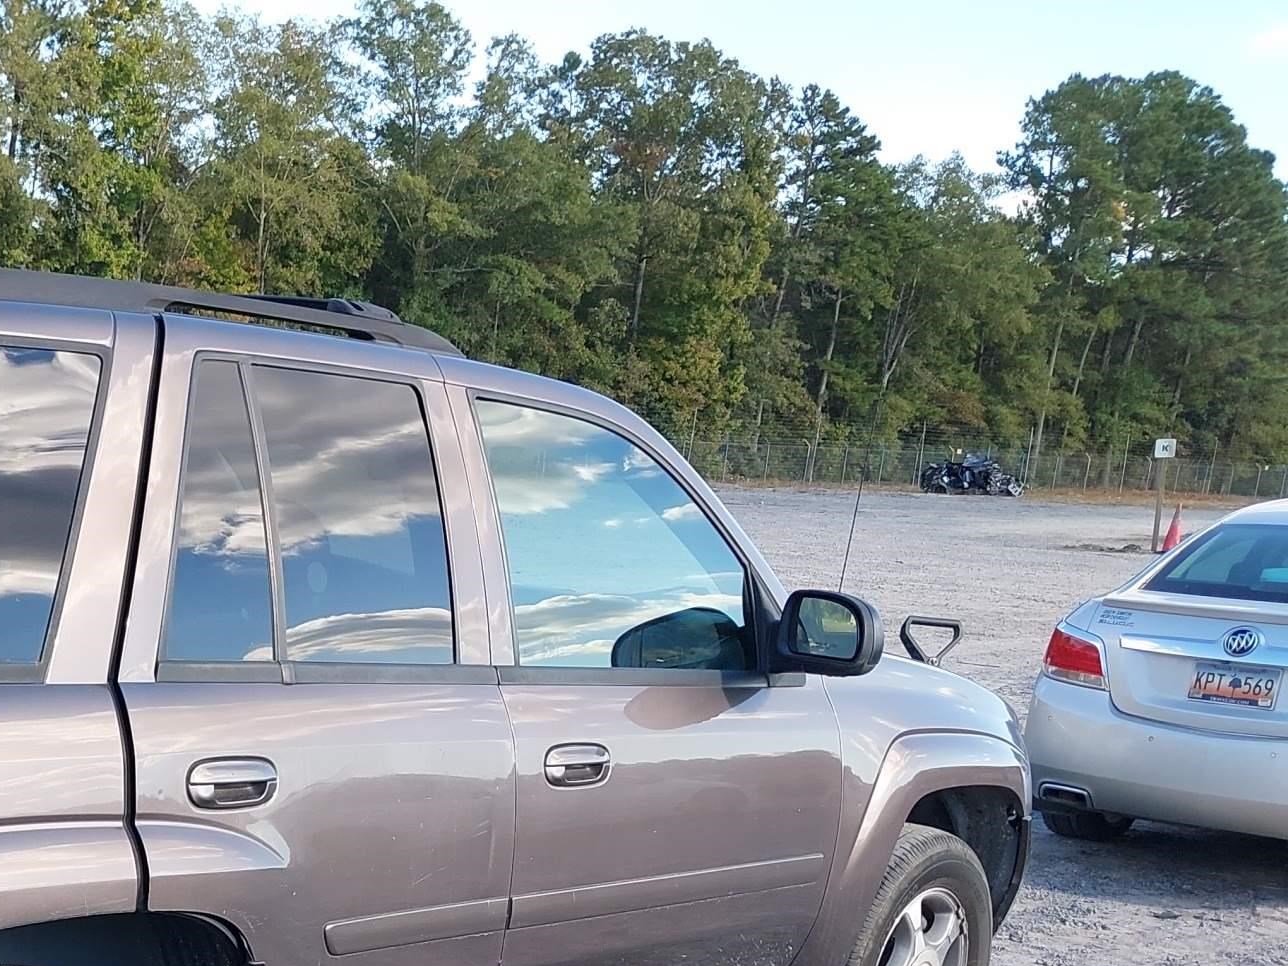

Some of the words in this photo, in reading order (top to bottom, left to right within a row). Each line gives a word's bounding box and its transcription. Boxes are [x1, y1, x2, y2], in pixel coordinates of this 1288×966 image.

[1161, 444, 1169, 452] K
[1193, 671, 1226, 691] KPT
[1242, 676, 1275, 697] 569
